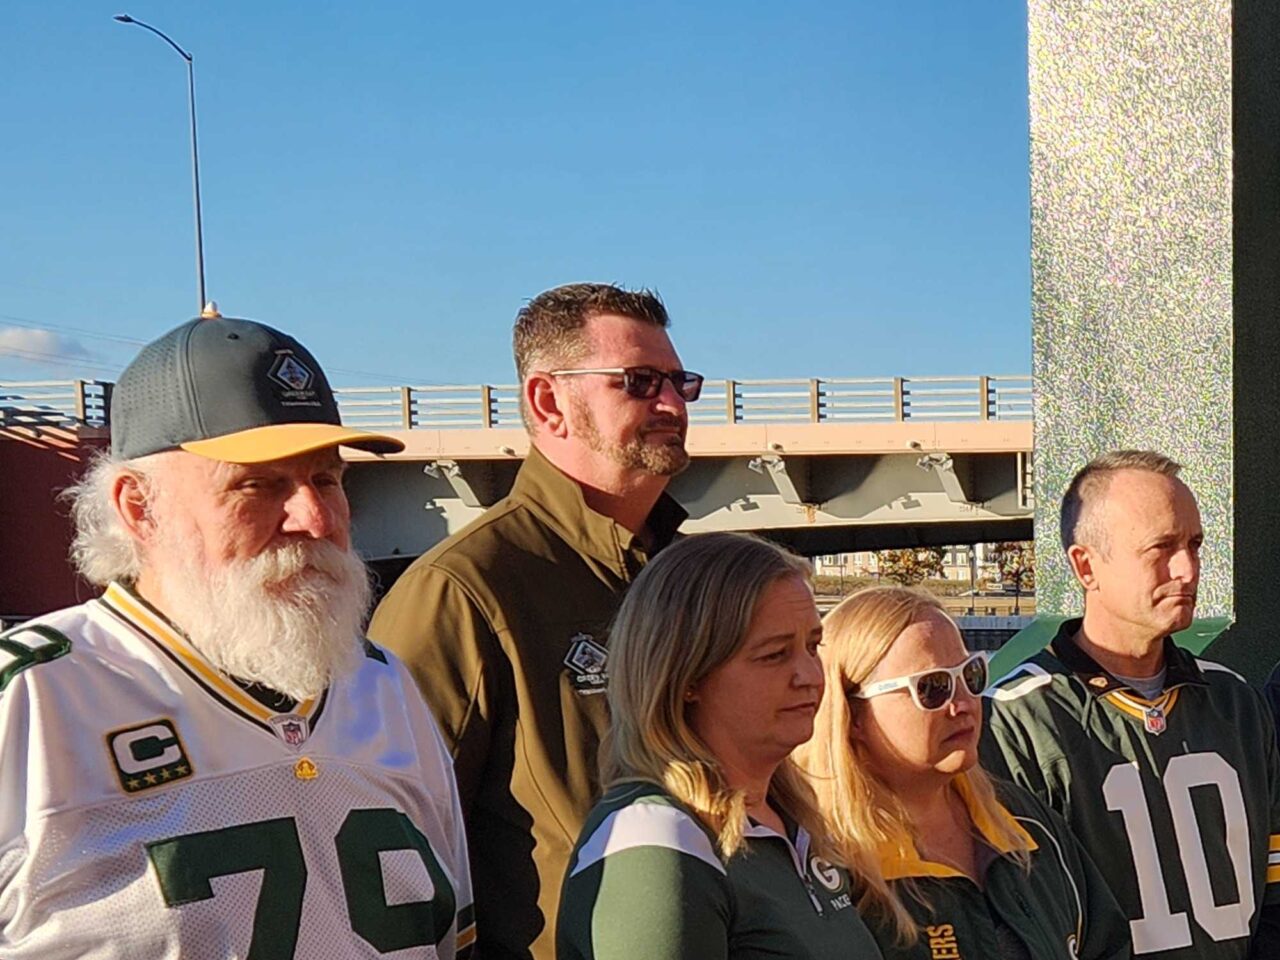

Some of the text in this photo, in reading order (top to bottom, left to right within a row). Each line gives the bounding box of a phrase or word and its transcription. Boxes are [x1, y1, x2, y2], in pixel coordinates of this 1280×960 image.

[113, 724, 182, 775] C
[810, 855, 842, 891] G
[1102, 752, 1256, 955] 10
